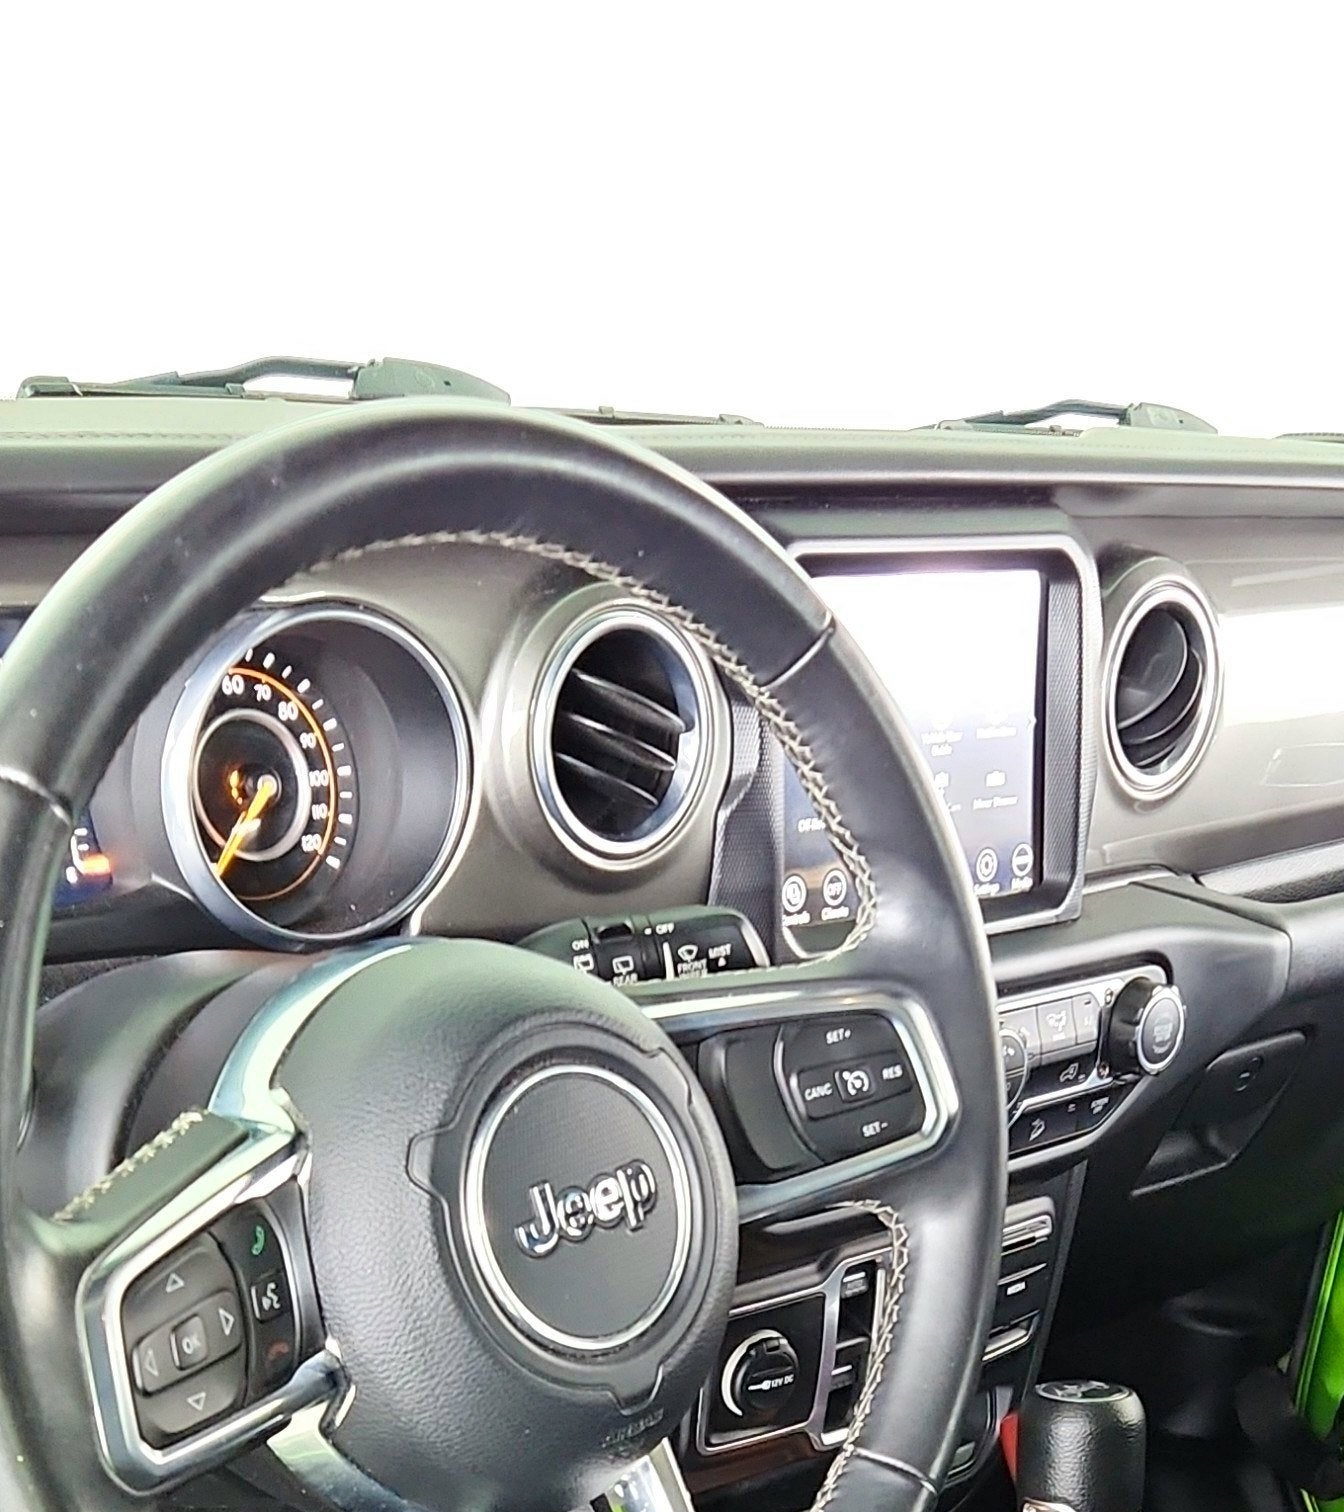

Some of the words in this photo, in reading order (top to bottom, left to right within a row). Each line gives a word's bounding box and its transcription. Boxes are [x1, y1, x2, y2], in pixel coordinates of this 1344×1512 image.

[221, 673, 245, 696] 60
[254, 683, 273, 702] 70
[277, 700, 299, 722] 80
[299, 733, 316, 749] 90
[309, 770, 329, 787] 100
[311, 805, 328, 820] 110
[301, 834, 321, 852] 120
[655, 922, 675, 936] OFF
[571, 939, 590, 952] ON
[881, 1063, 904, 1081] RES
[514, 1159, 657, 1259] Jeep
[181, 1333, 202, 1355] OK
